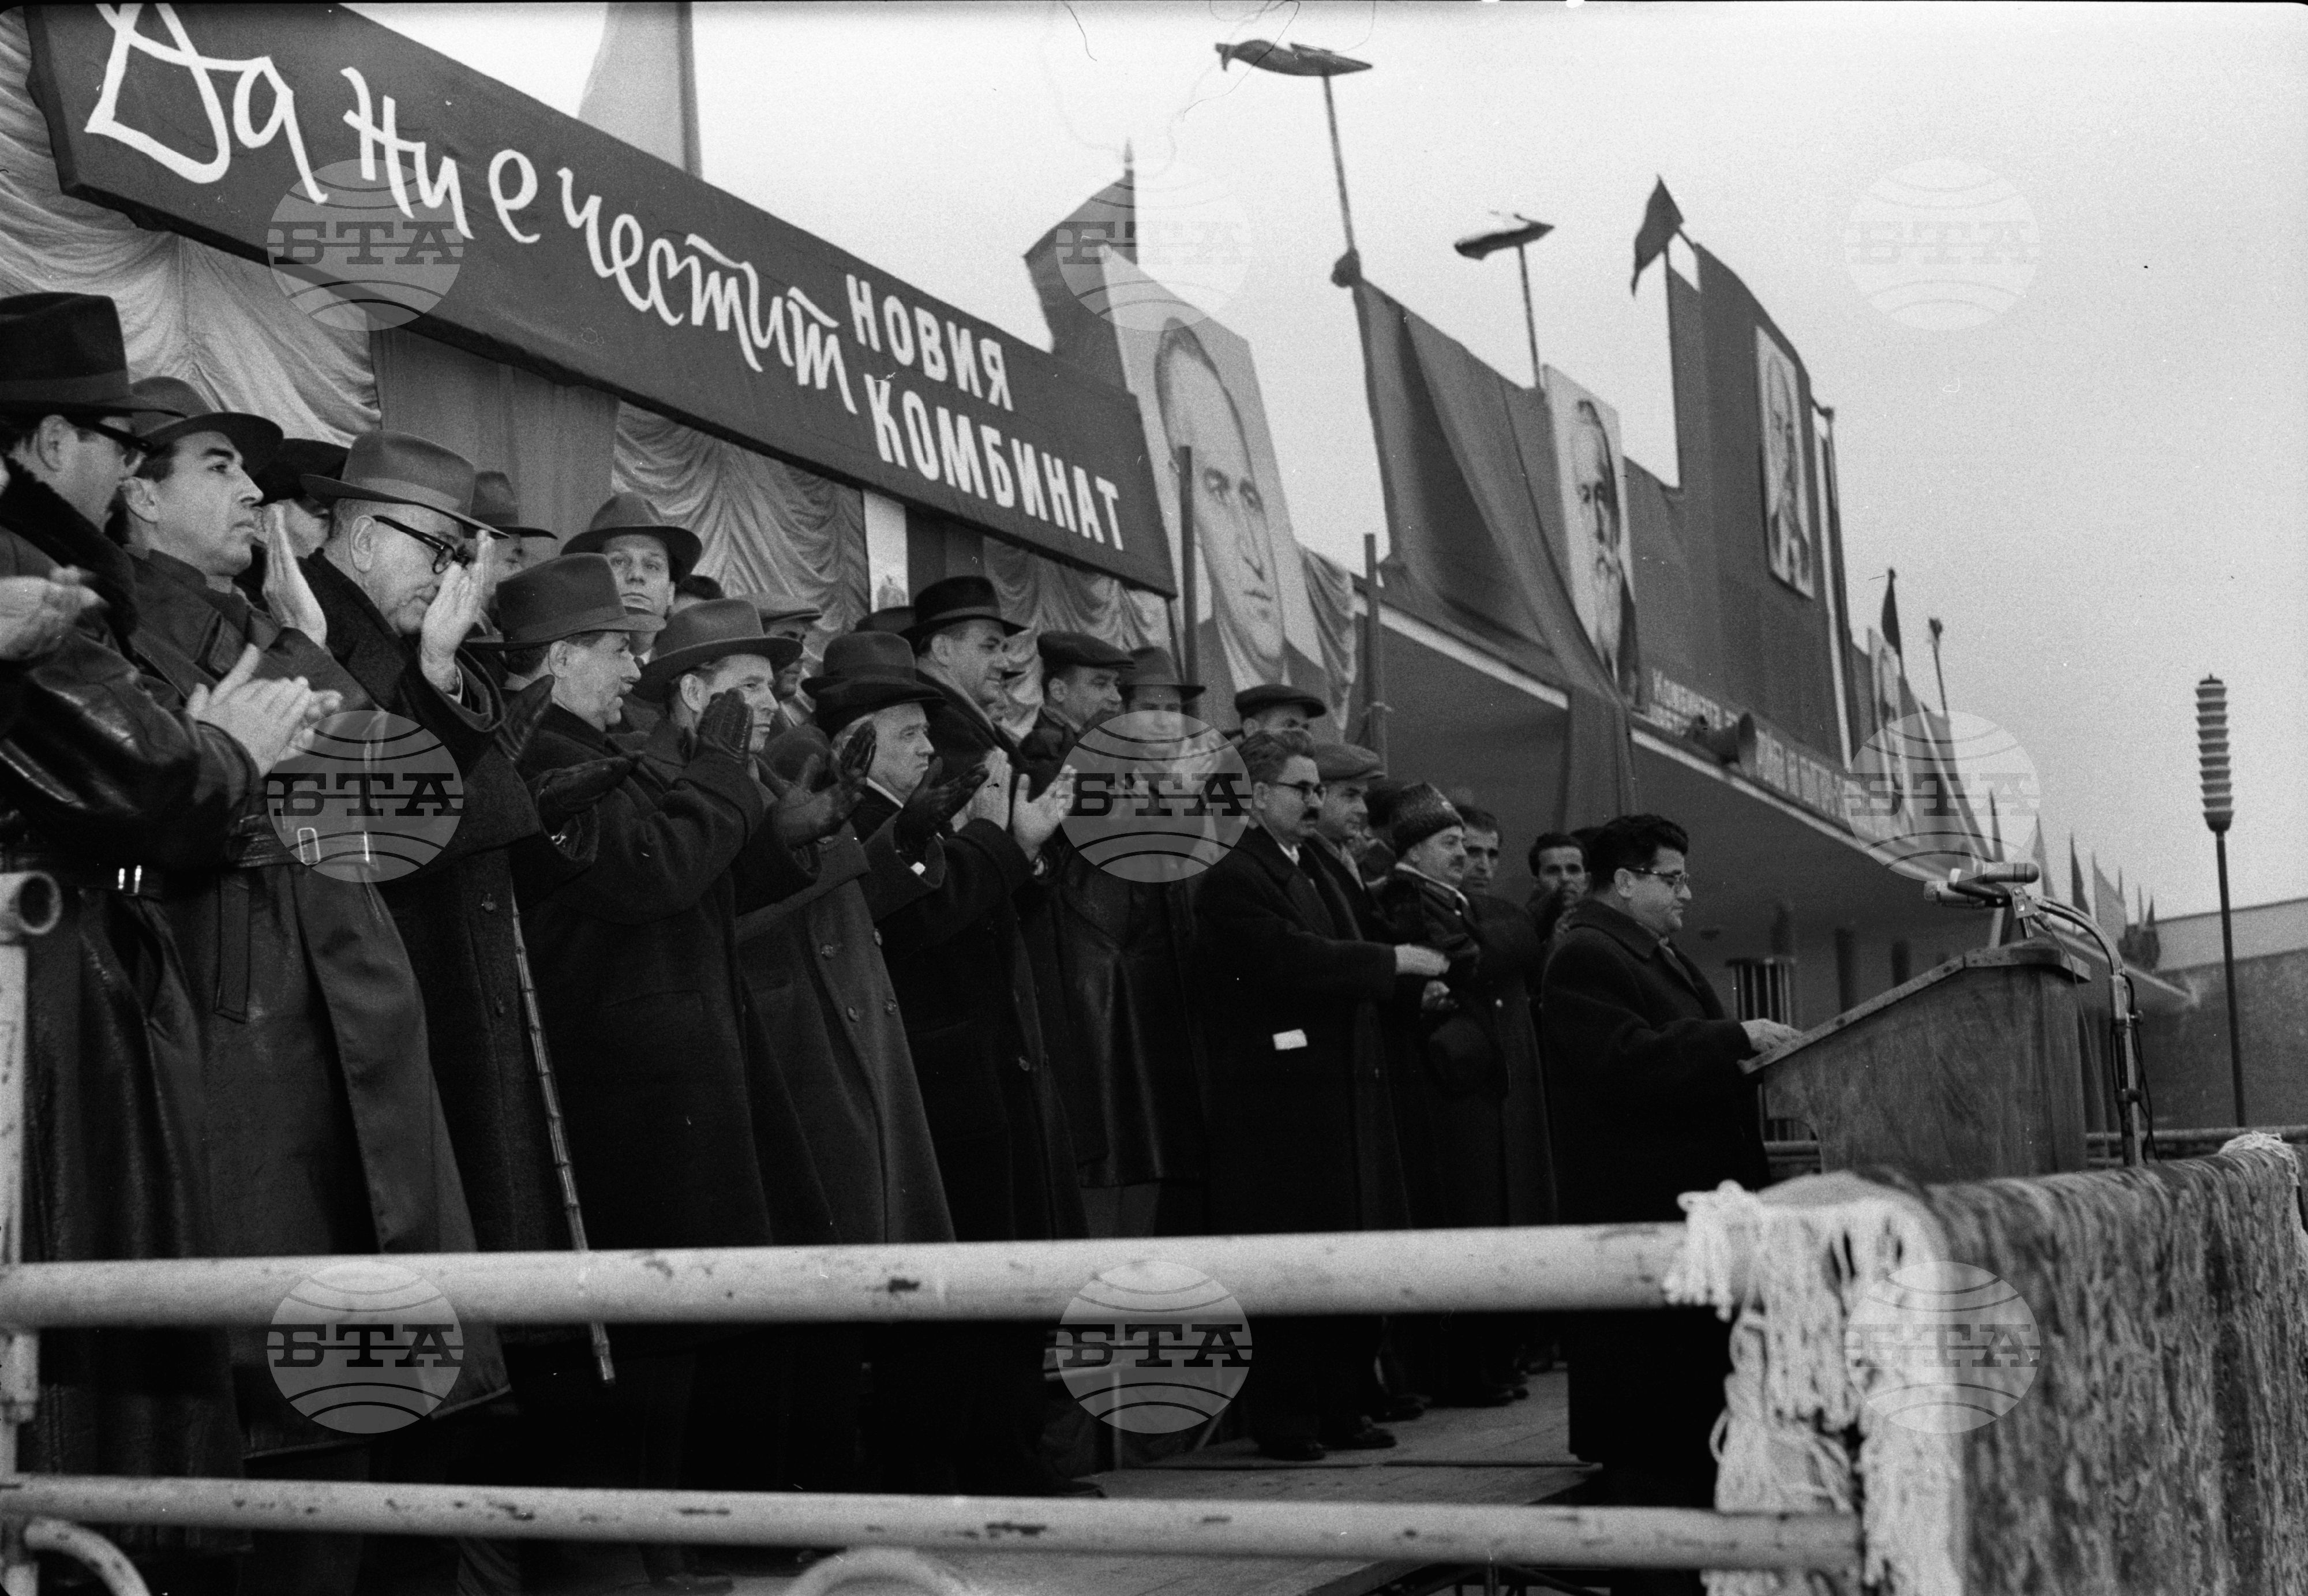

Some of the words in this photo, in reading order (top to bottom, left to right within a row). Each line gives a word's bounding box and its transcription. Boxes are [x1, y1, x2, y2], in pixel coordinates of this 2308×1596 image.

[84, 2, 328, 204] Да
[341, 67, 474, 239] ни
[488, 148, 541, 243] е
[556, 167, 858, 415] честит
[846, 274, 1013, 411] НОВИЯ
[864, 374, 1125, 550] КОМБИНАТ
